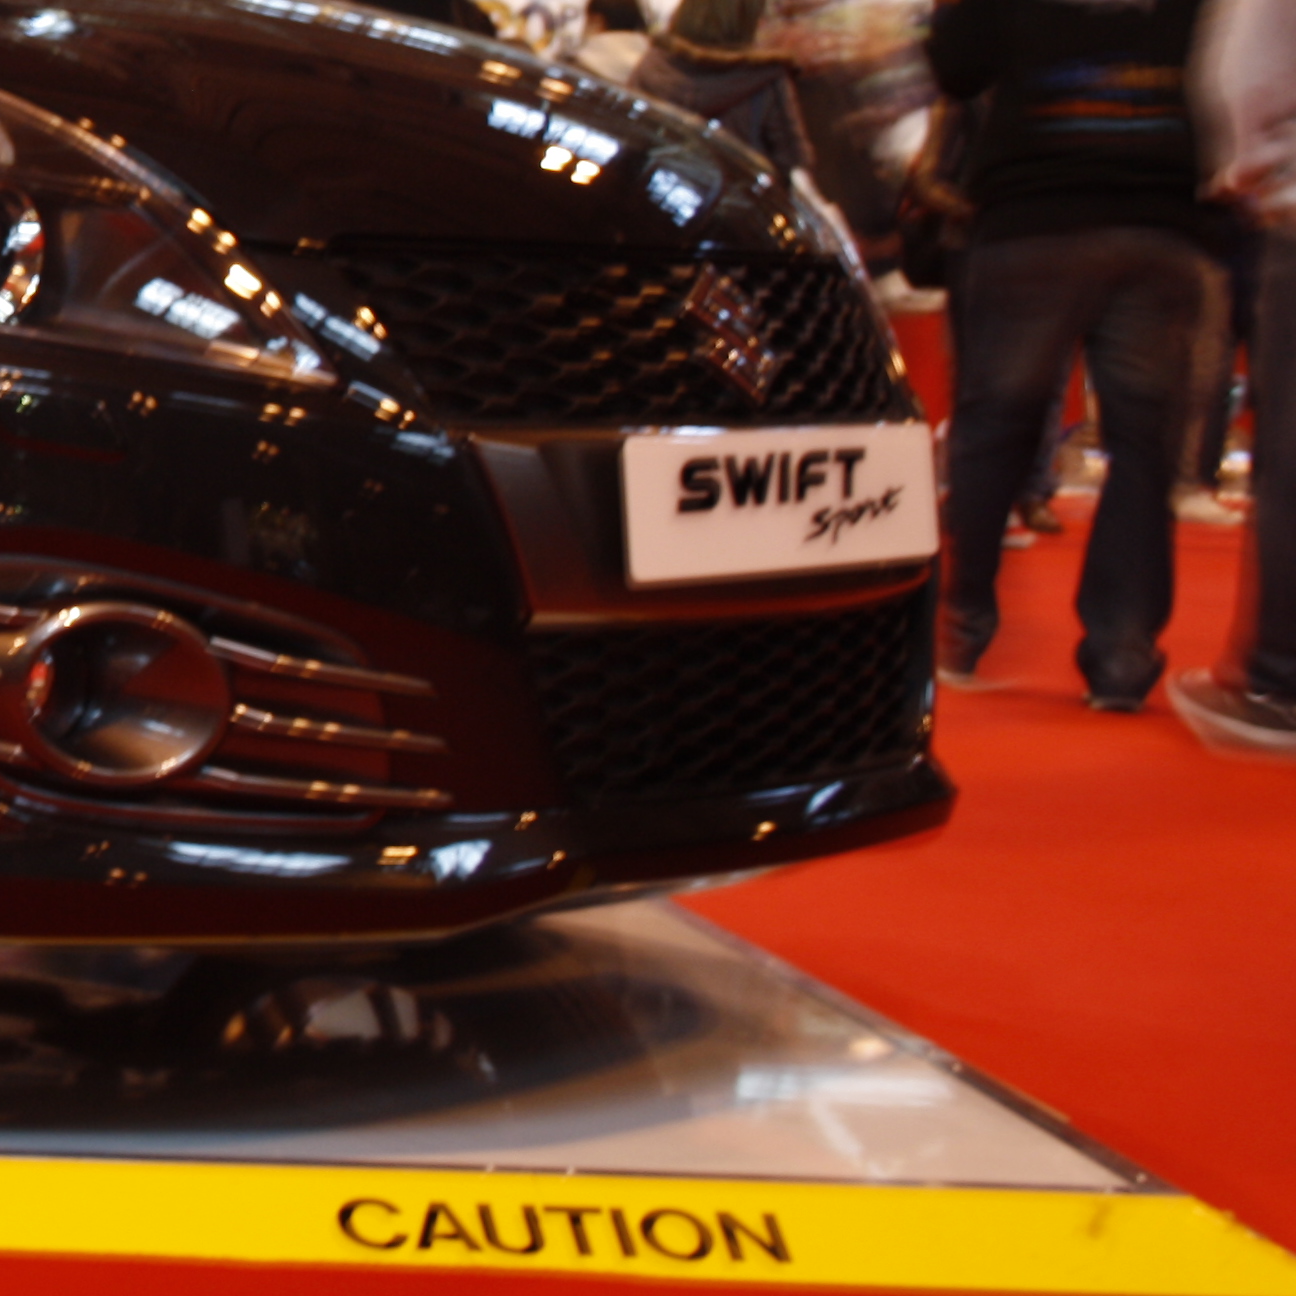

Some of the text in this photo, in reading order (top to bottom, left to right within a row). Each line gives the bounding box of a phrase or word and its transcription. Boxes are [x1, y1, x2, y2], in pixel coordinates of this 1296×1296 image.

[676, 446, 866, 514] SWIFT
[805, 486, 904, 545] Sport
[337, 1197, 793, 1263] CAUTION
